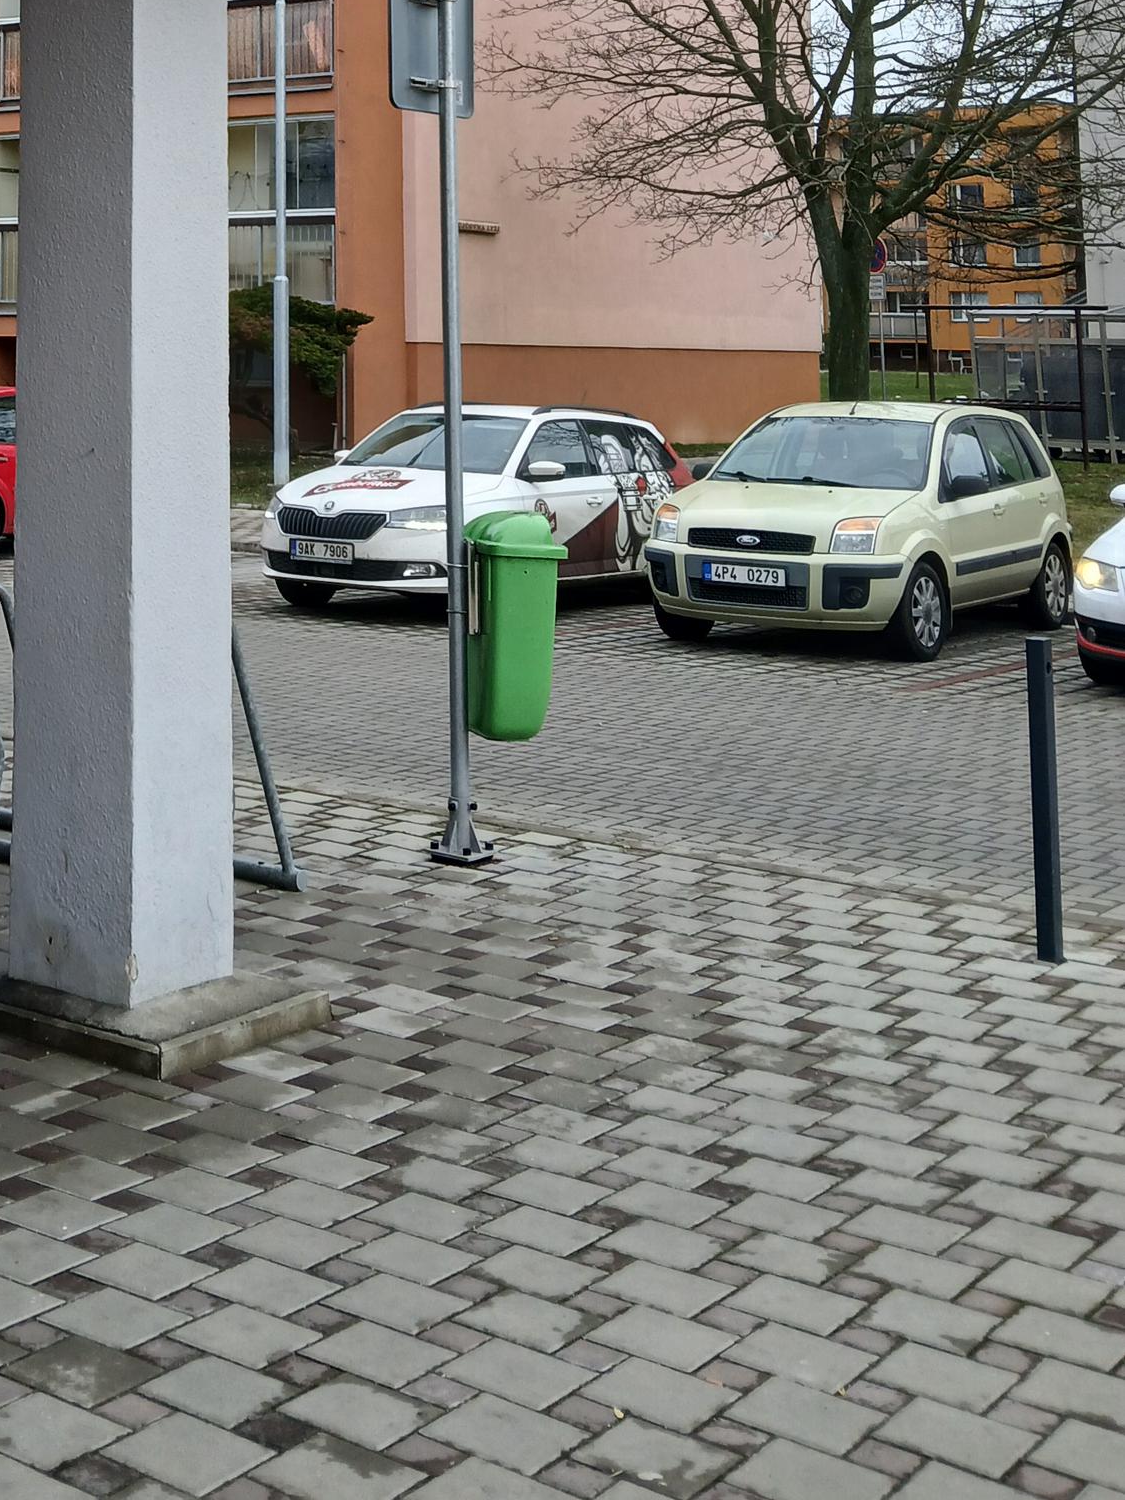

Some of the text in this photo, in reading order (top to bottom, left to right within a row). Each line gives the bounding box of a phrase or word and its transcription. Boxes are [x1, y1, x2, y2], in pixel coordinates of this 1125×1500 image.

[298, 542, 348, 559] 9AK 7906
[714, 565, 779, 584] 4P4 0279
